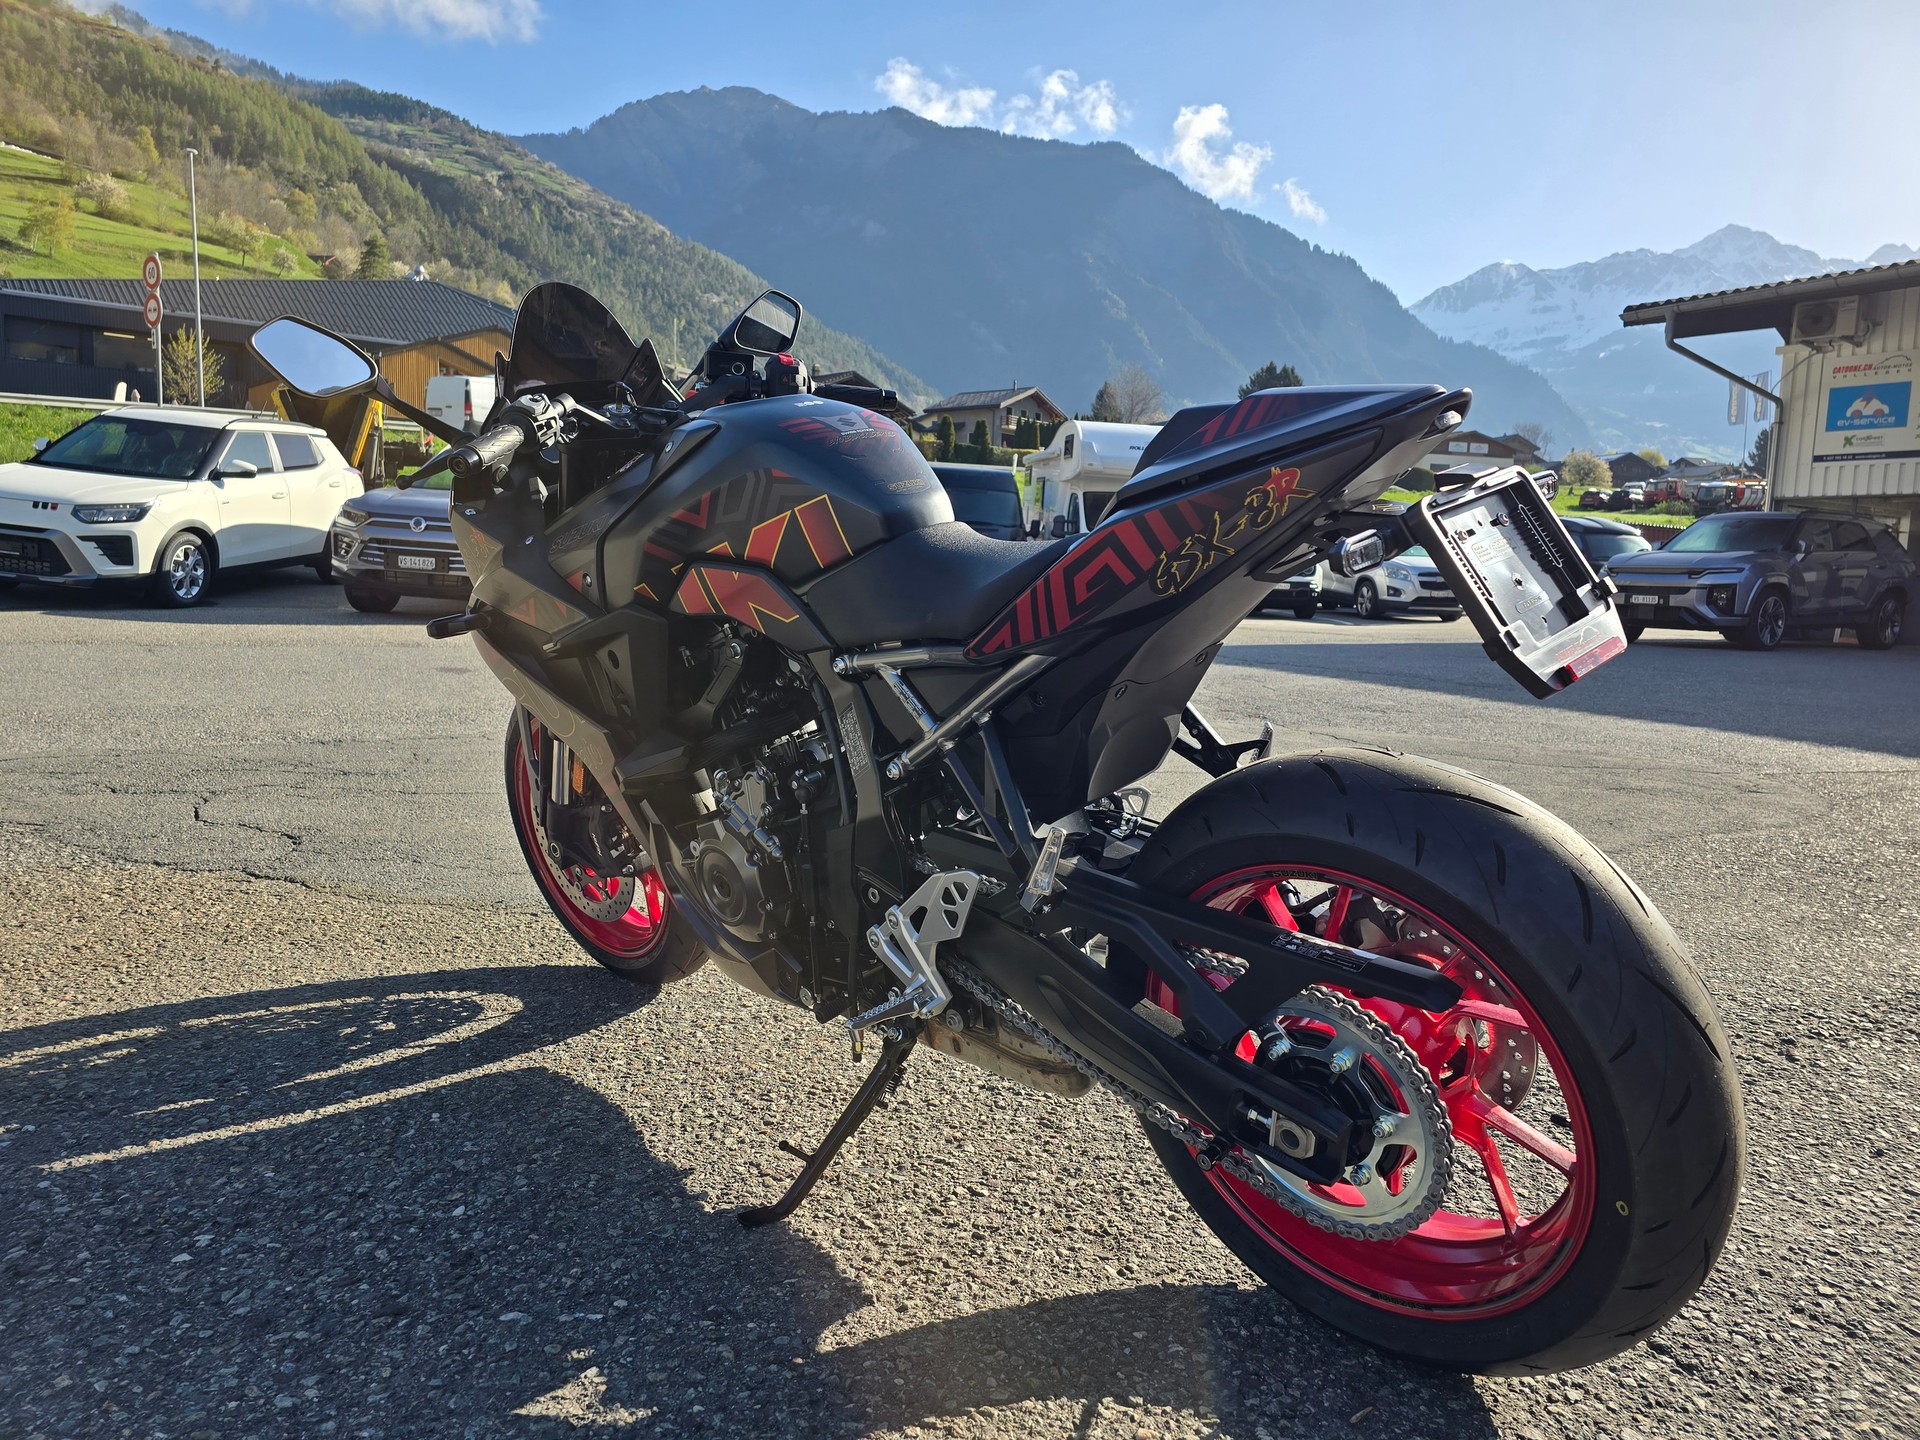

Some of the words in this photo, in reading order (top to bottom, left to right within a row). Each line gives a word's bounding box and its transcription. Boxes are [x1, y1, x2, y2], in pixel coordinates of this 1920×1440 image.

[148, 266, 156, 280] 60
[549, 512, 610, 554] SUZUKI
[1272, 868, 1319, 880] SUZUKI
